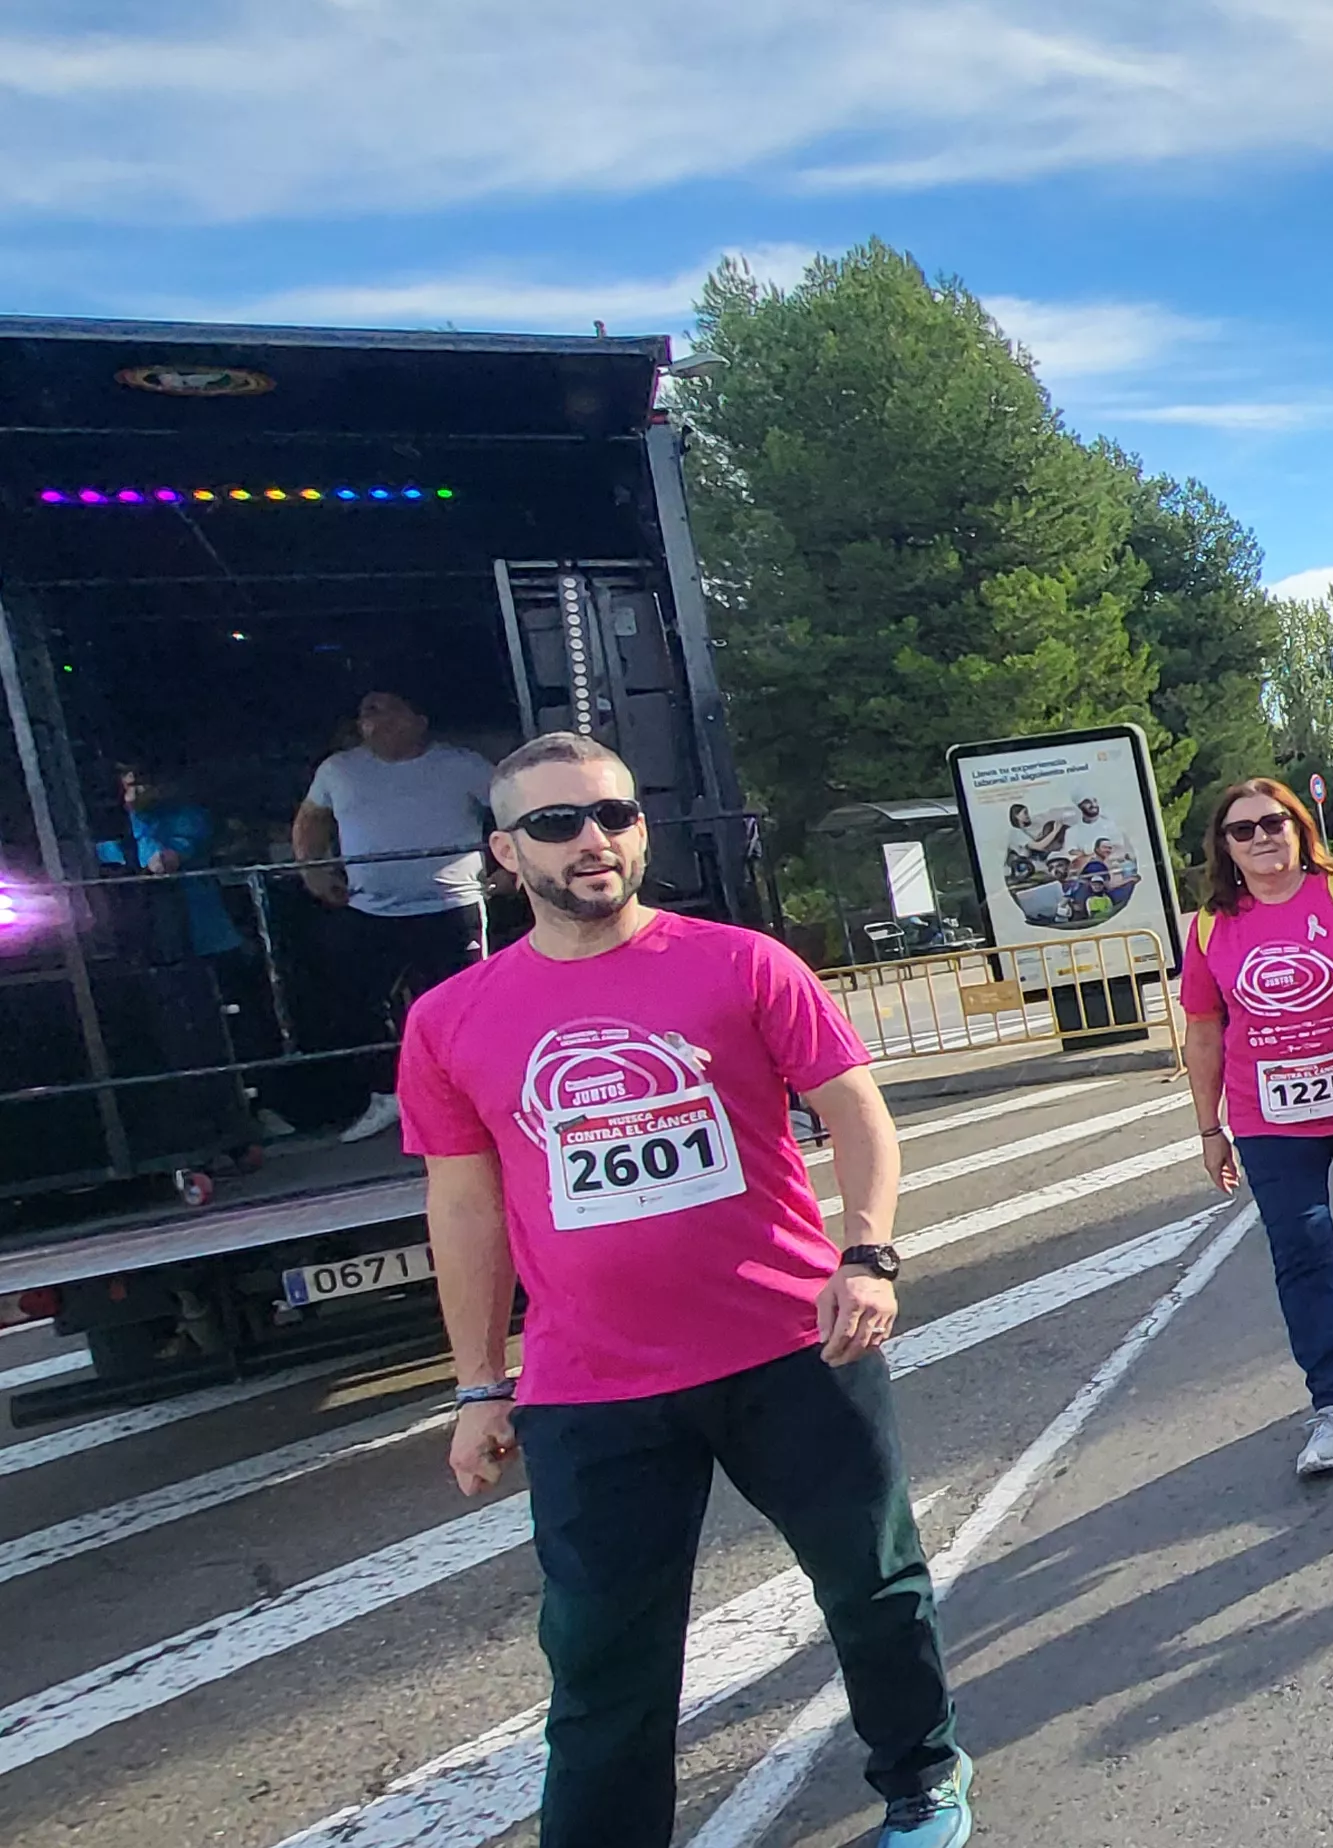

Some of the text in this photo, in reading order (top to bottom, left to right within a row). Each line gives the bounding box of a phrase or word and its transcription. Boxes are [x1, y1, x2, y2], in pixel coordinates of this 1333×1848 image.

[1011, 759, 1067, 774] experiencia
[1022, 768, 1064, 781] siguiente
[1067, 763, 1088, 773] nivel
[567, 1109, 709, 1143] CONTRA EL CÁNCER
[608, 1112, 654, 1126] HUESCA
[567, 1128, 715, 1193] 2601
[313, 1253, 409, 1293] 0671
